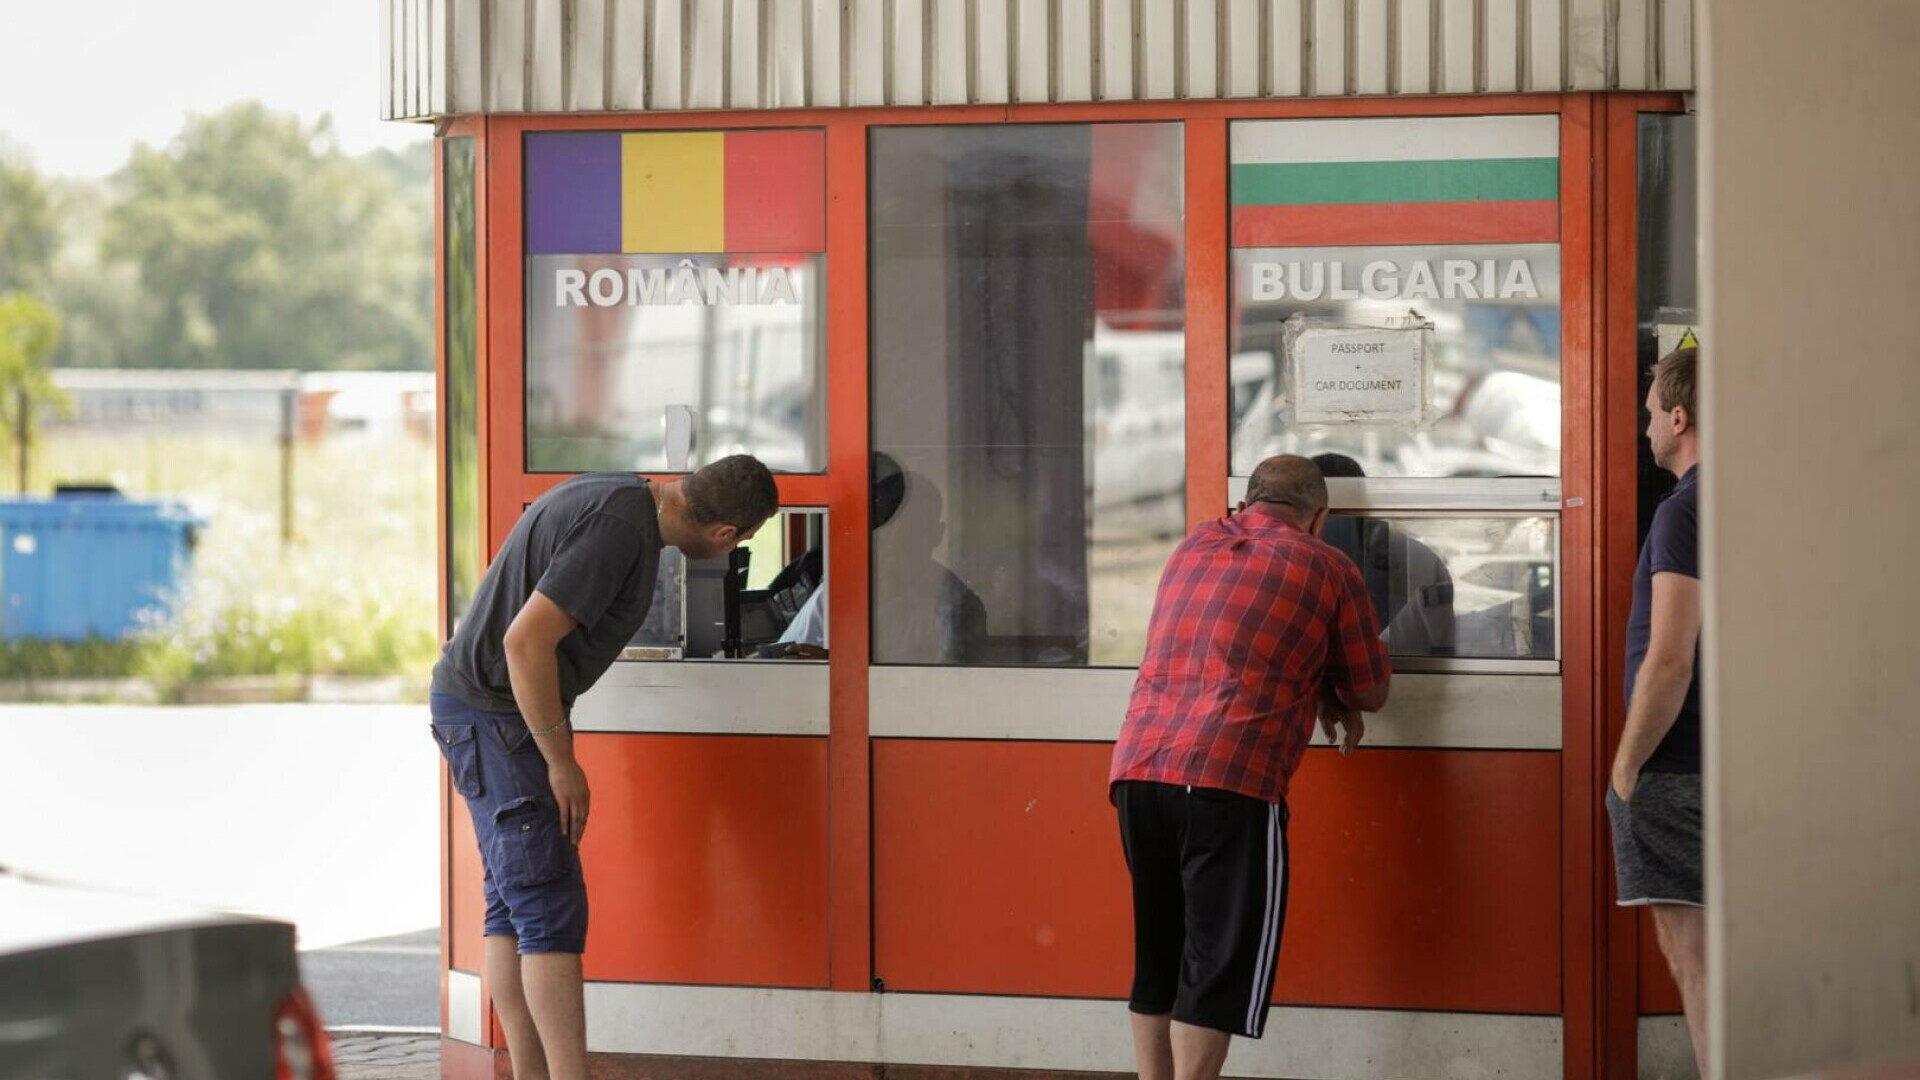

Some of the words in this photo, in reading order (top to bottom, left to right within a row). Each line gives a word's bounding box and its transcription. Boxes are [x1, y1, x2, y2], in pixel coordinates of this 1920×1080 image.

[555, 258, 799, 307] ROMÂNIA
[1251, 258, 1539, 301] BULGARIA
[1331, 342, 1385, 354] PASSPORT
[1315, 380, 1336, 391] CAR
[1338, 379, 1402, 391] DOCUMENT
